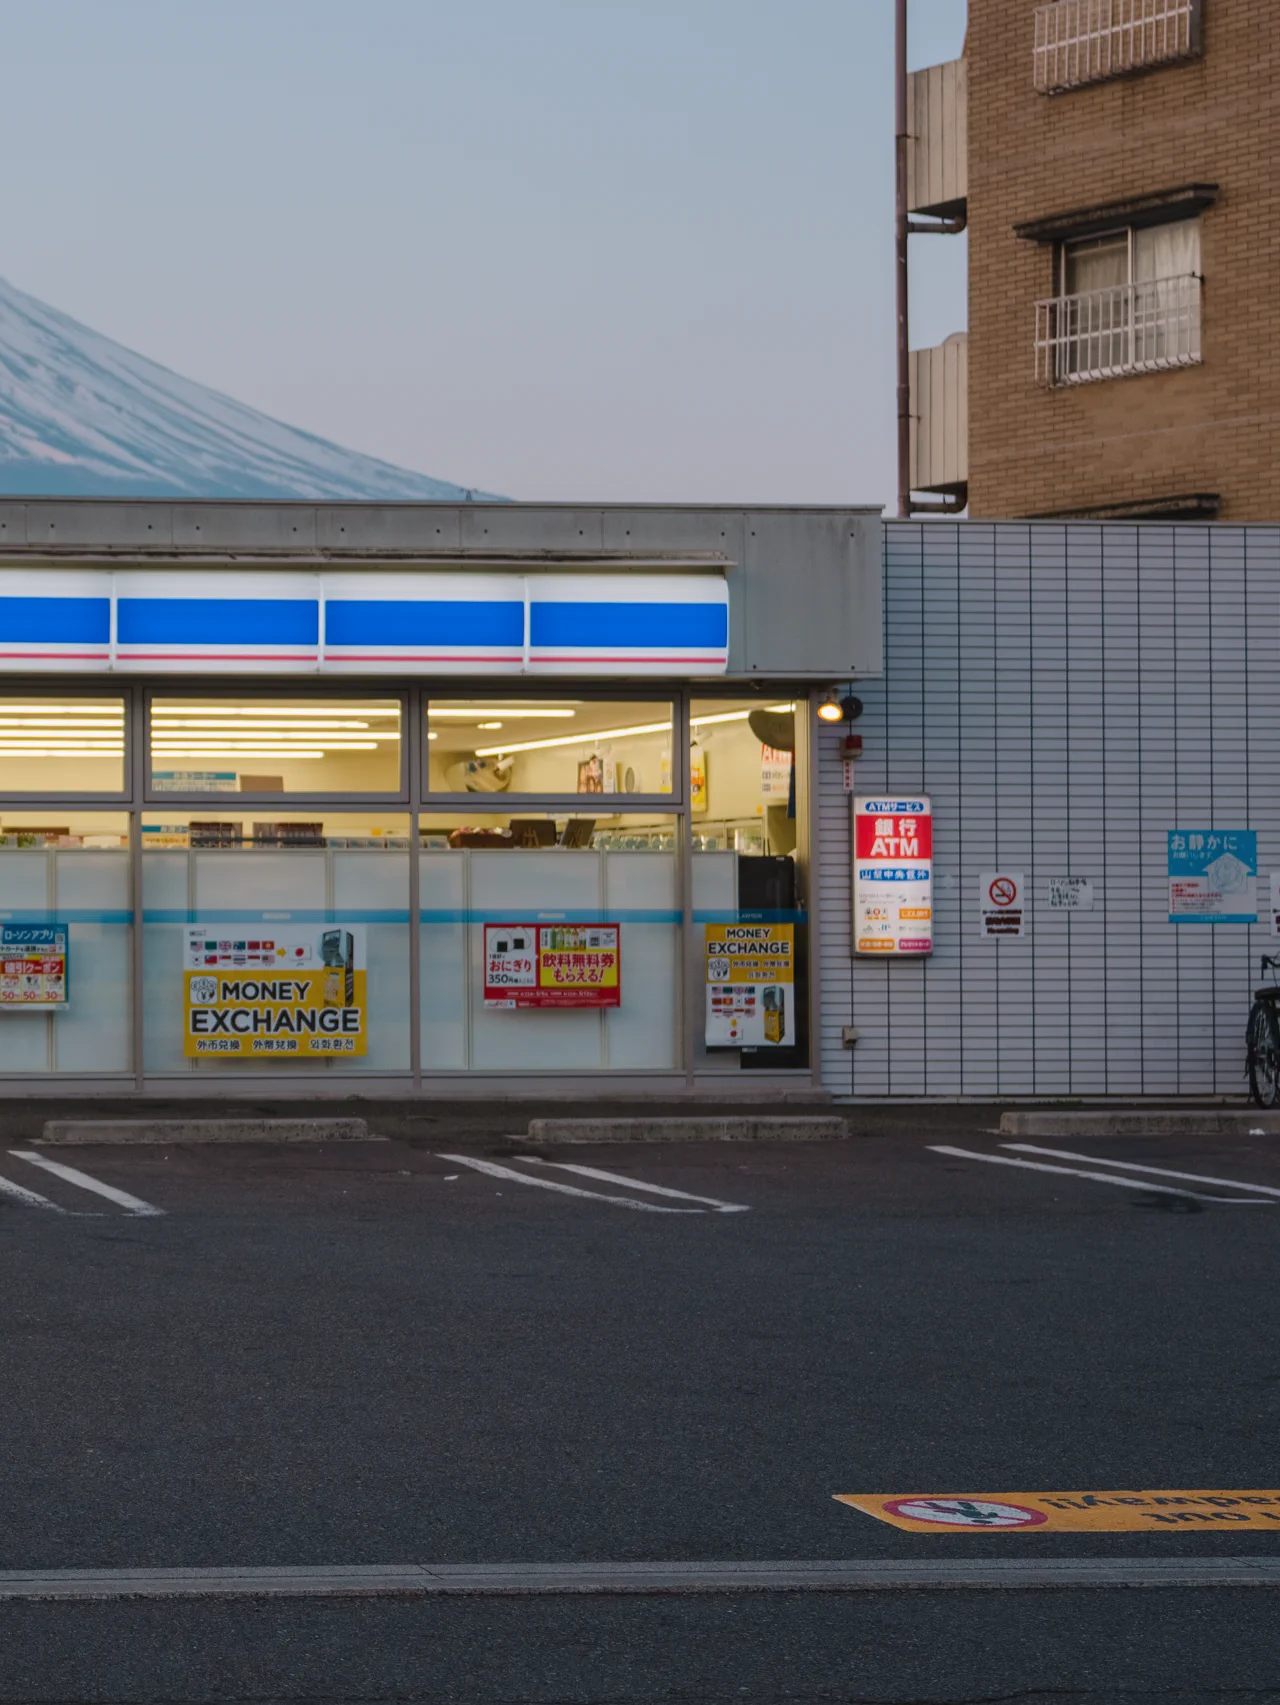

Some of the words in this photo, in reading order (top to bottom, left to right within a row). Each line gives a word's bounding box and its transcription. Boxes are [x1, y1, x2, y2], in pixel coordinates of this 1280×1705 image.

[868, 802, 921, 812] ATMサービス
[874, 818, 917, 837] 銀行
[870, 838, 919, 856] ATM
[1170, 834, 1238, 851] お静かに
[4, 929, 54, 941] ローソンアプリ
[726, 929, 771, 939] MONEY
[708, 942, 790, 955] EXCHANGE
[489, 959, 532, 973] おにぎり
[542, 953, 616, 968] 飲料無料券
[552, 969, 605, 983] もらえる!
[222, 982, 310, 1000] MONEY
[191, 1009, 360, 1033] EXCHANGE
[1140, 1512, 1252, 1525] out
